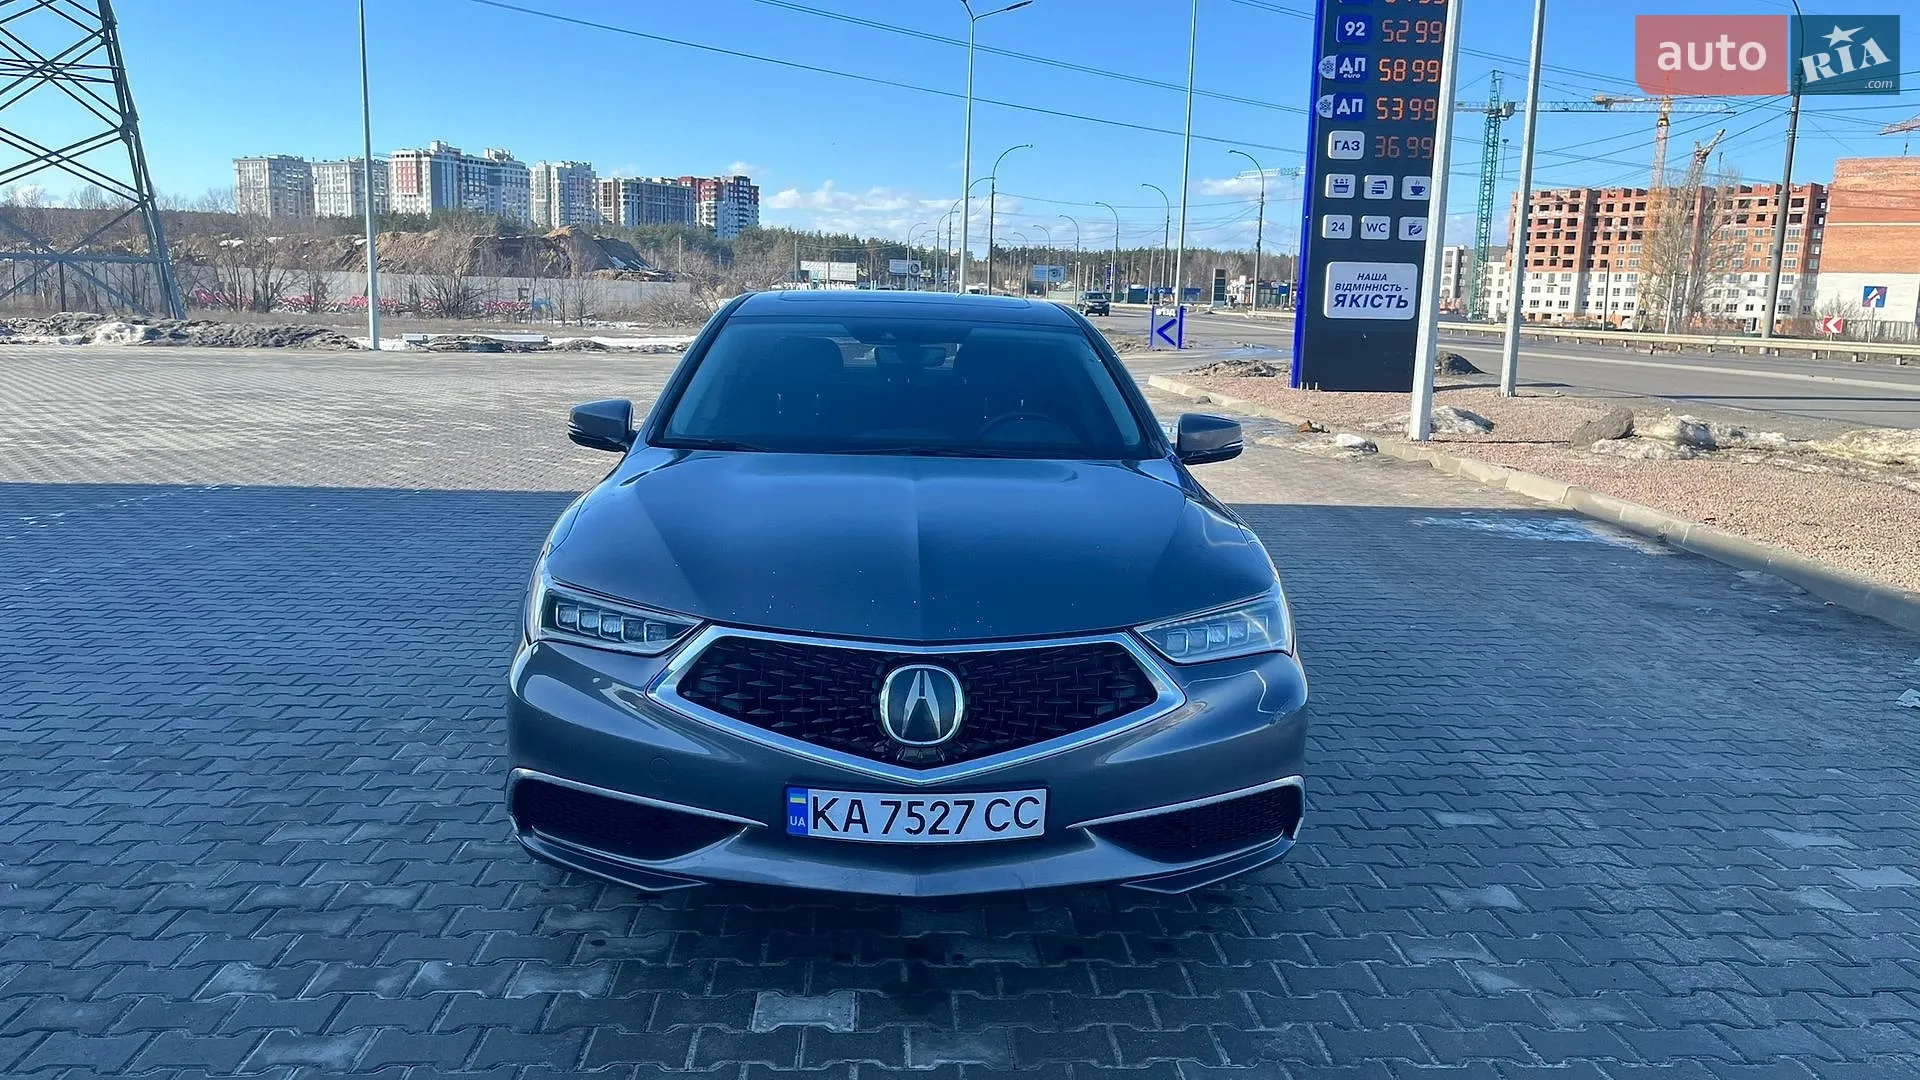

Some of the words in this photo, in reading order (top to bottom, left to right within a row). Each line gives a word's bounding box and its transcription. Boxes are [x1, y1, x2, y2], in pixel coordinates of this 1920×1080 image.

[1344, 21, 1366, 37] 92
[1381, 19, 1410, 43] 52
[1415, 20, 1443, 44] 99
[1339, 57, 1366, 74] ДП
[1379, 58, 1407, 82] 58
[1412, 59, 1440, 83] 99
[1336, 98, 1363, 115] ДП
[1376, 97, 1405, 121] 53
[1409, 98, 1437, 121] 99
[1334, 140, 1360, 151] ГАЗ
[1374, 135, 1401, 158] 36
[1406, 136, 1433, 159] 99
[1331, 221, 1345, 232] 24
[1366, 223, 1387, 233] WC
[1357, 273, 1387, 281] НАША
[1334, 283, 1402, 292] ВІДМІННІСТЬ
[1333, 293, 1409, 309] ЯКІСТЬ
[790, 815, 806, 827] UA
[811, 796, 869, 834] KA
[880, 799, 975, 835] 7527
[984, 796, 1040, 832] CC
